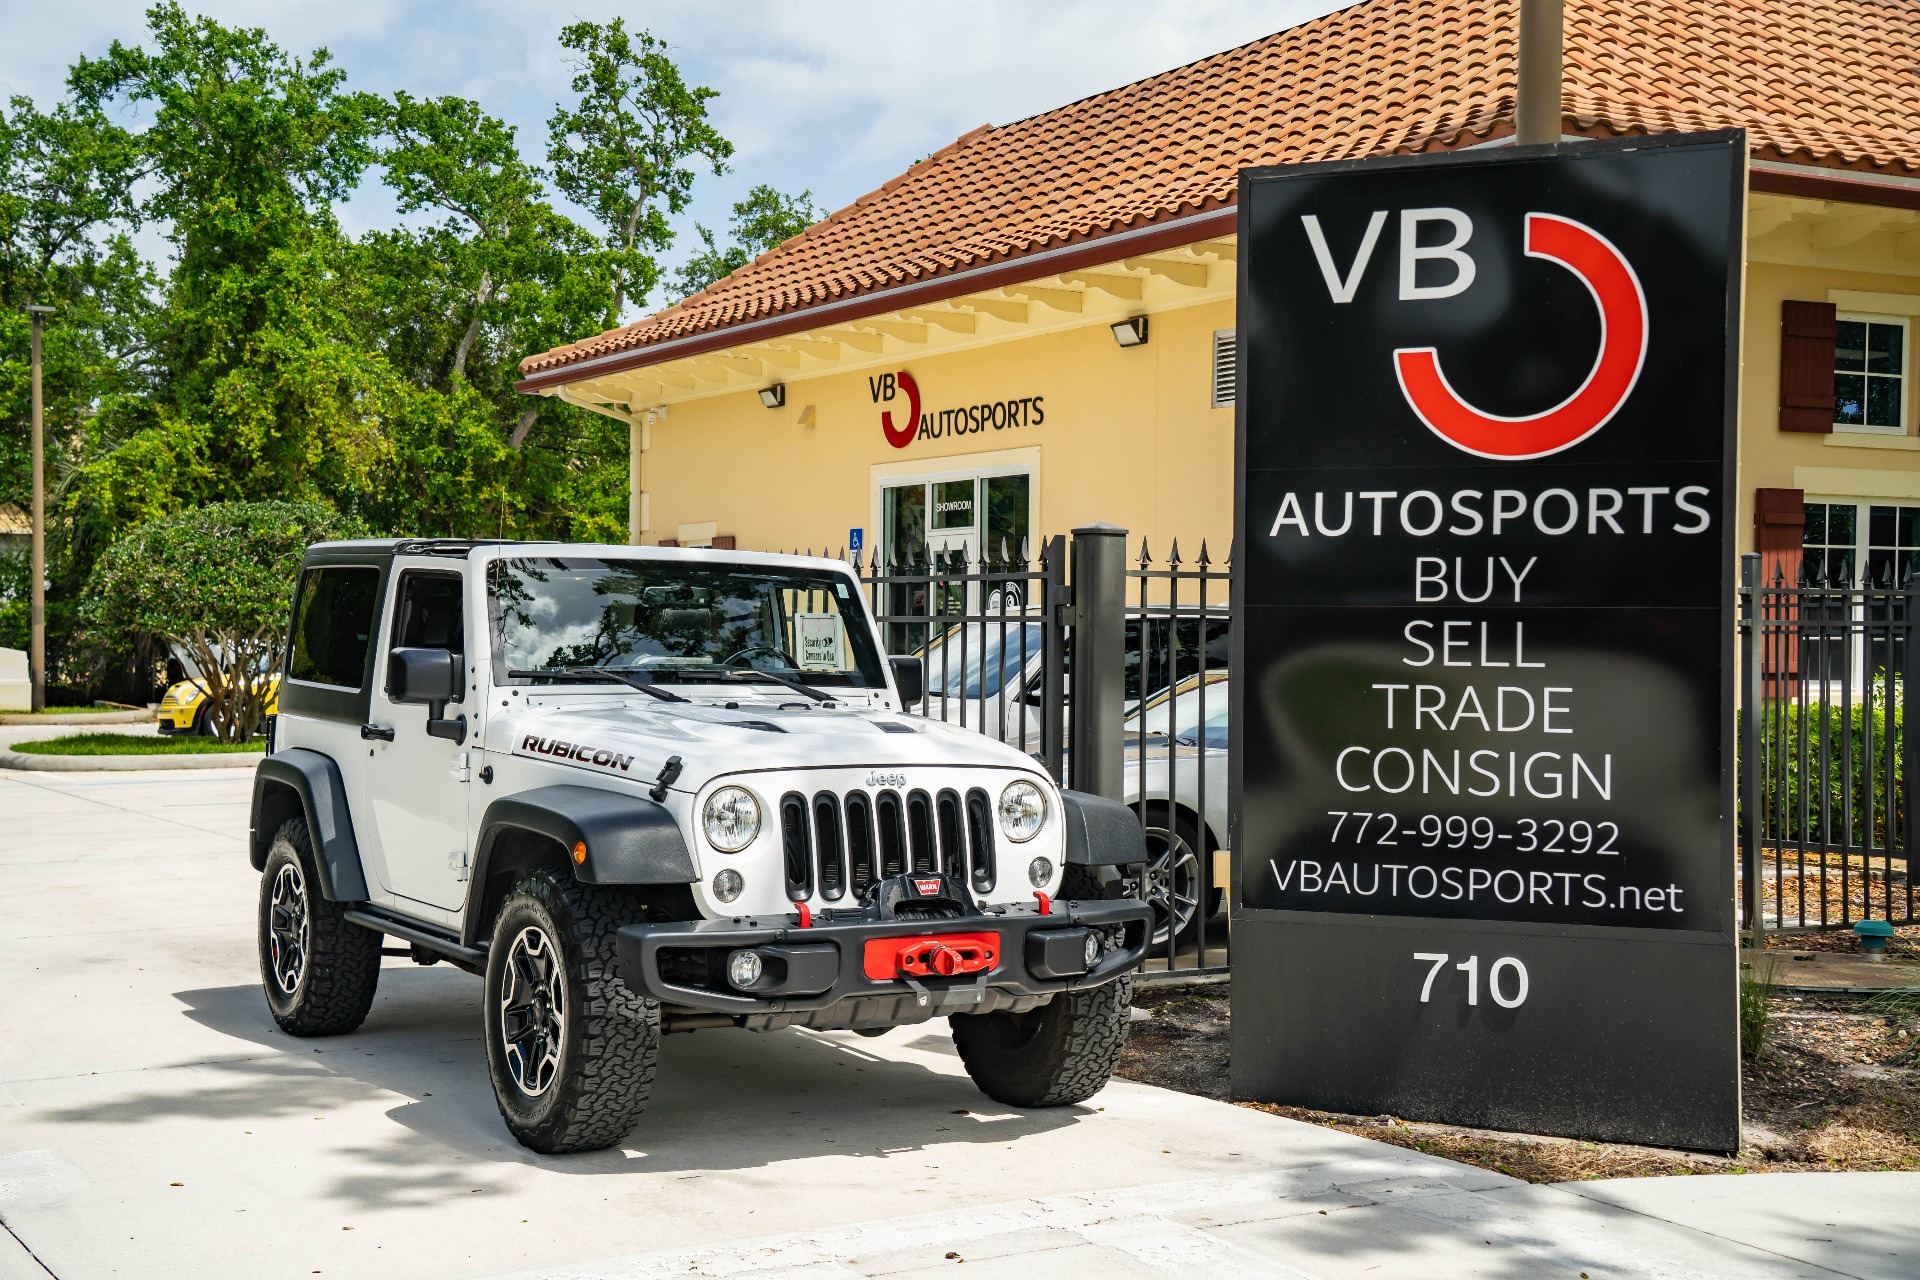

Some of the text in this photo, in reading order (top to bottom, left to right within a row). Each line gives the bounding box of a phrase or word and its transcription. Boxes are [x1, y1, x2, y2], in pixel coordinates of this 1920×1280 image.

[1301, 207, 1477, 304] VB
[869, 373, 896, 403] VB
[917, 396, 1044, 441] AUTOSPORTS
[936, 500, 972, 513] SHOWROOM
[1269, 485, 1711, 537] AUTOSPORTS
[1415, 556, 1538, 603] BUY
[1402, 620, 1546, 668] SELL
[1372, 683, 1574, 734] TRADE
[521, 734, 635, 772] RUBICON
[1336, 746, 1612, 801] CONSIGN
[865, 770, 907, 789] Jeep
[1327, 811, 1620, 856] 772-999-3292
[920, 883, 938, 891] WARN
[1269, 859, 1684, 913] VBAUTOSPORTS.net
[1413, 952, 1529, 1009] 710
